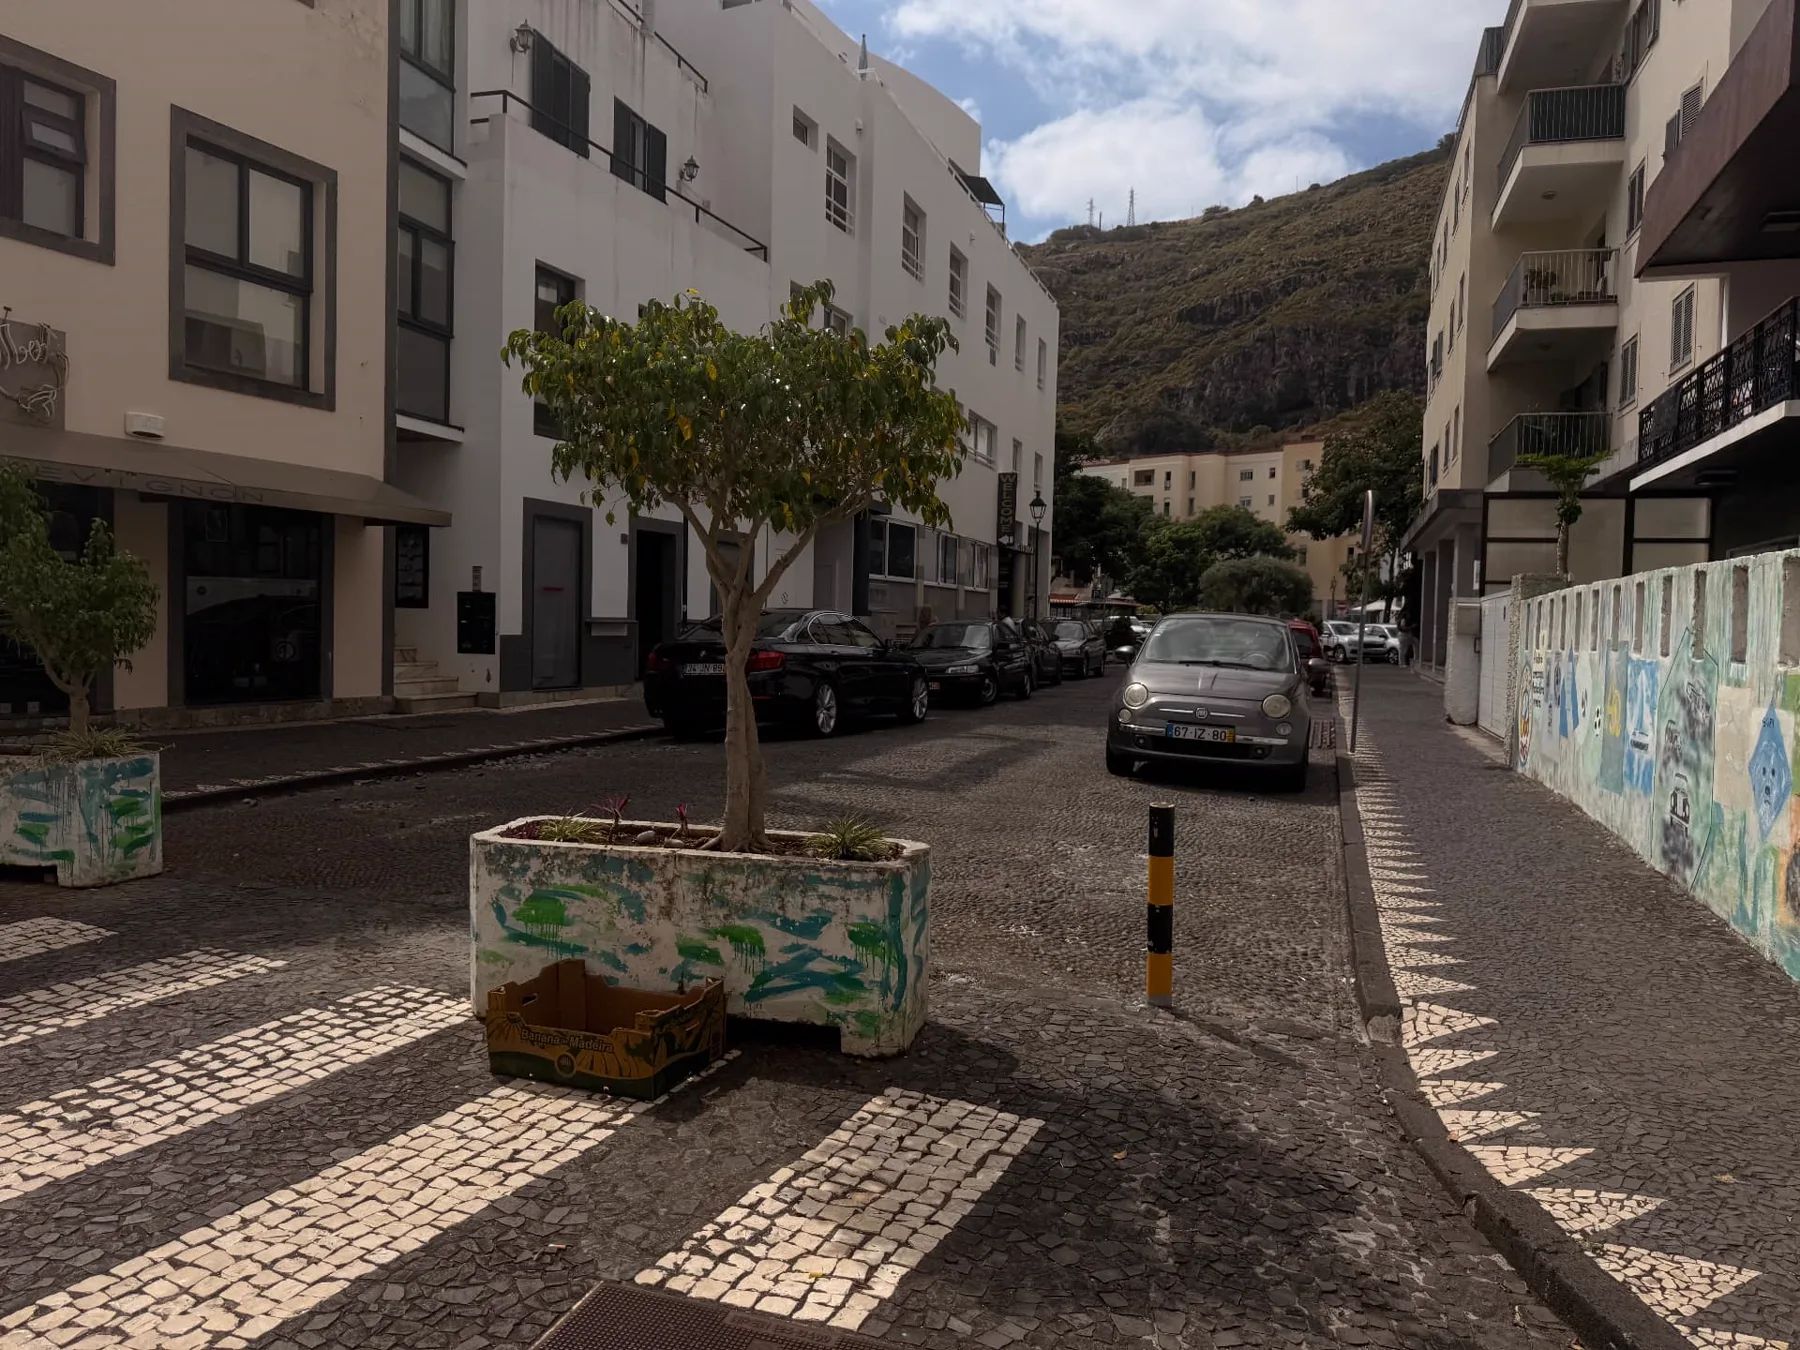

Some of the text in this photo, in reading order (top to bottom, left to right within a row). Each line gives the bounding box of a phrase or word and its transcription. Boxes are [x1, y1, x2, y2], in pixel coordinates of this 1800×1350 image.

[1000, 475, 1017, 533] WELCOME
[521, 1028, 560, 1045] Banana
[569, 1036, 614, 1053] Madeira
